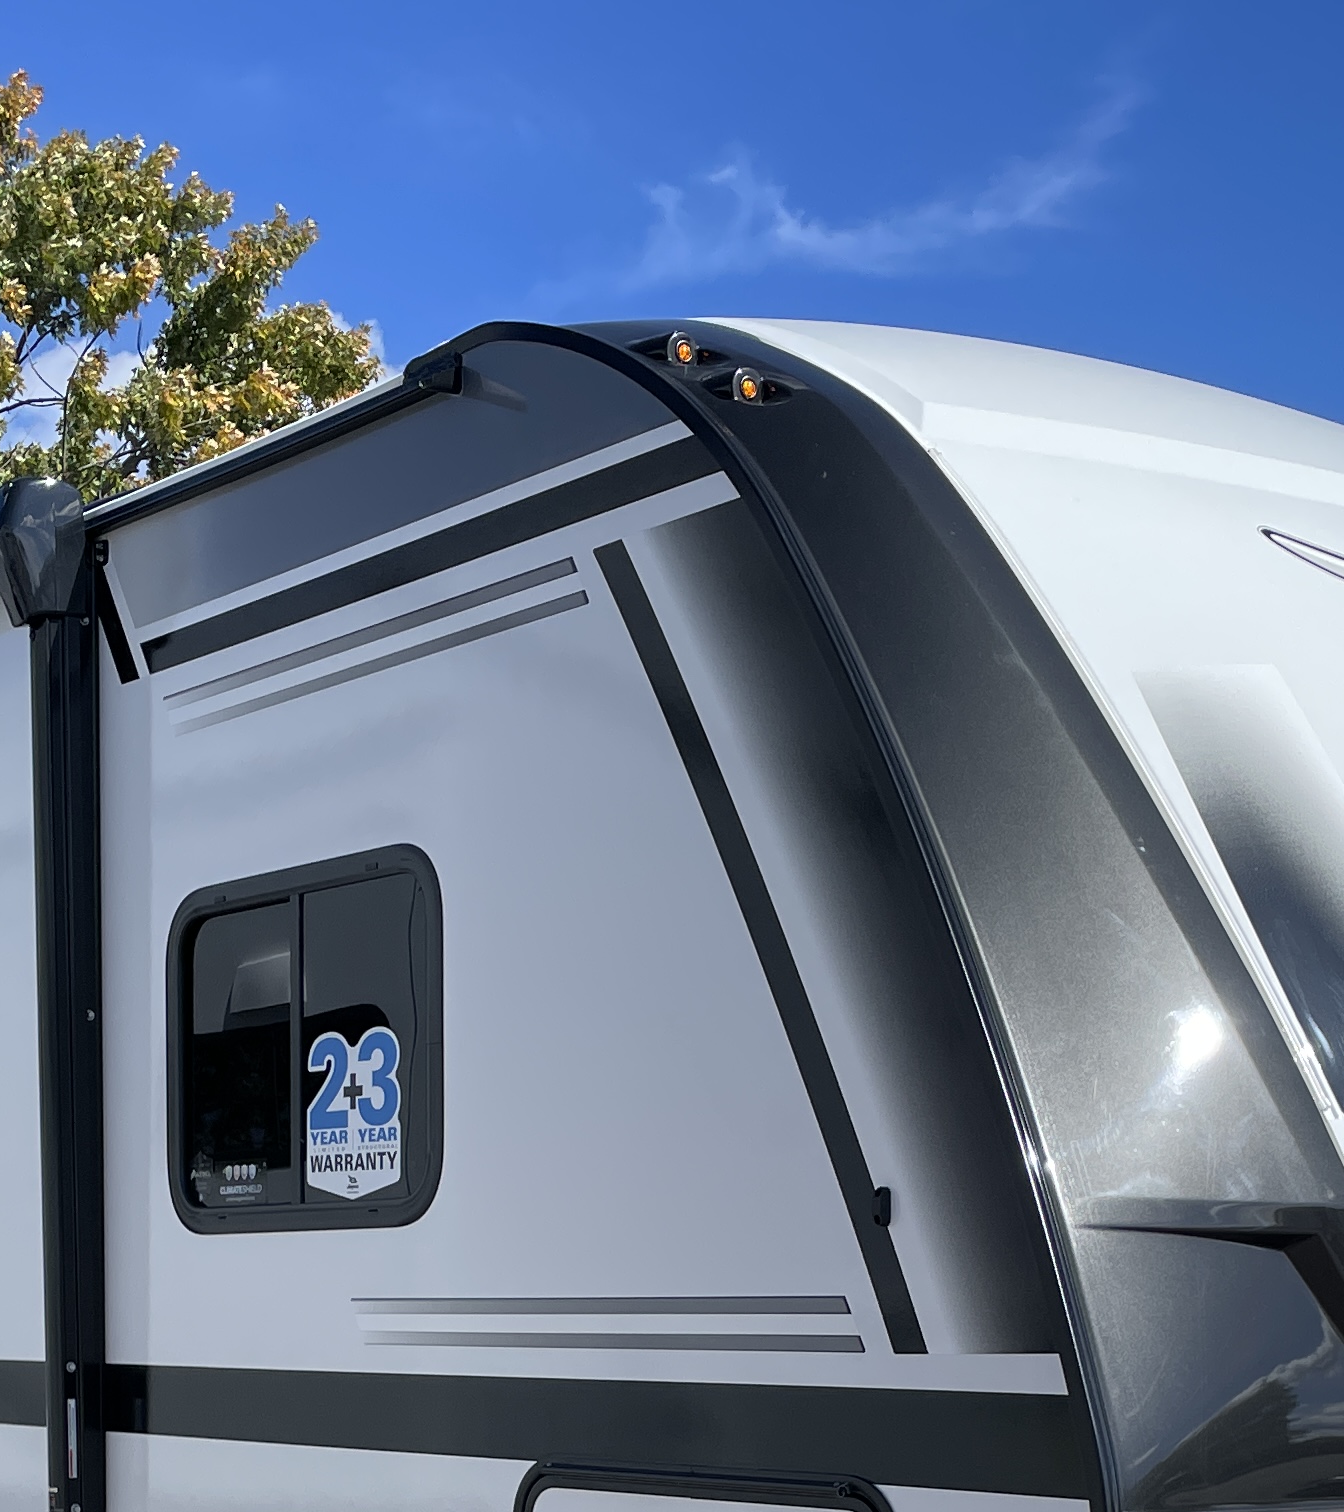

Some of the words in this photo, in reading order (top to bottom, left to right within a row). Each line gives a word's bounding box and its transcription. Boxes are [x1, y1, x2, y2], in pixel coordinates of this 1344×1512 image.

[311, 1130, 348, 1146] YEAR
[358, 1126, 398, 1142] YEAR
[310, 1151, 398, 1173] WARRANTY
